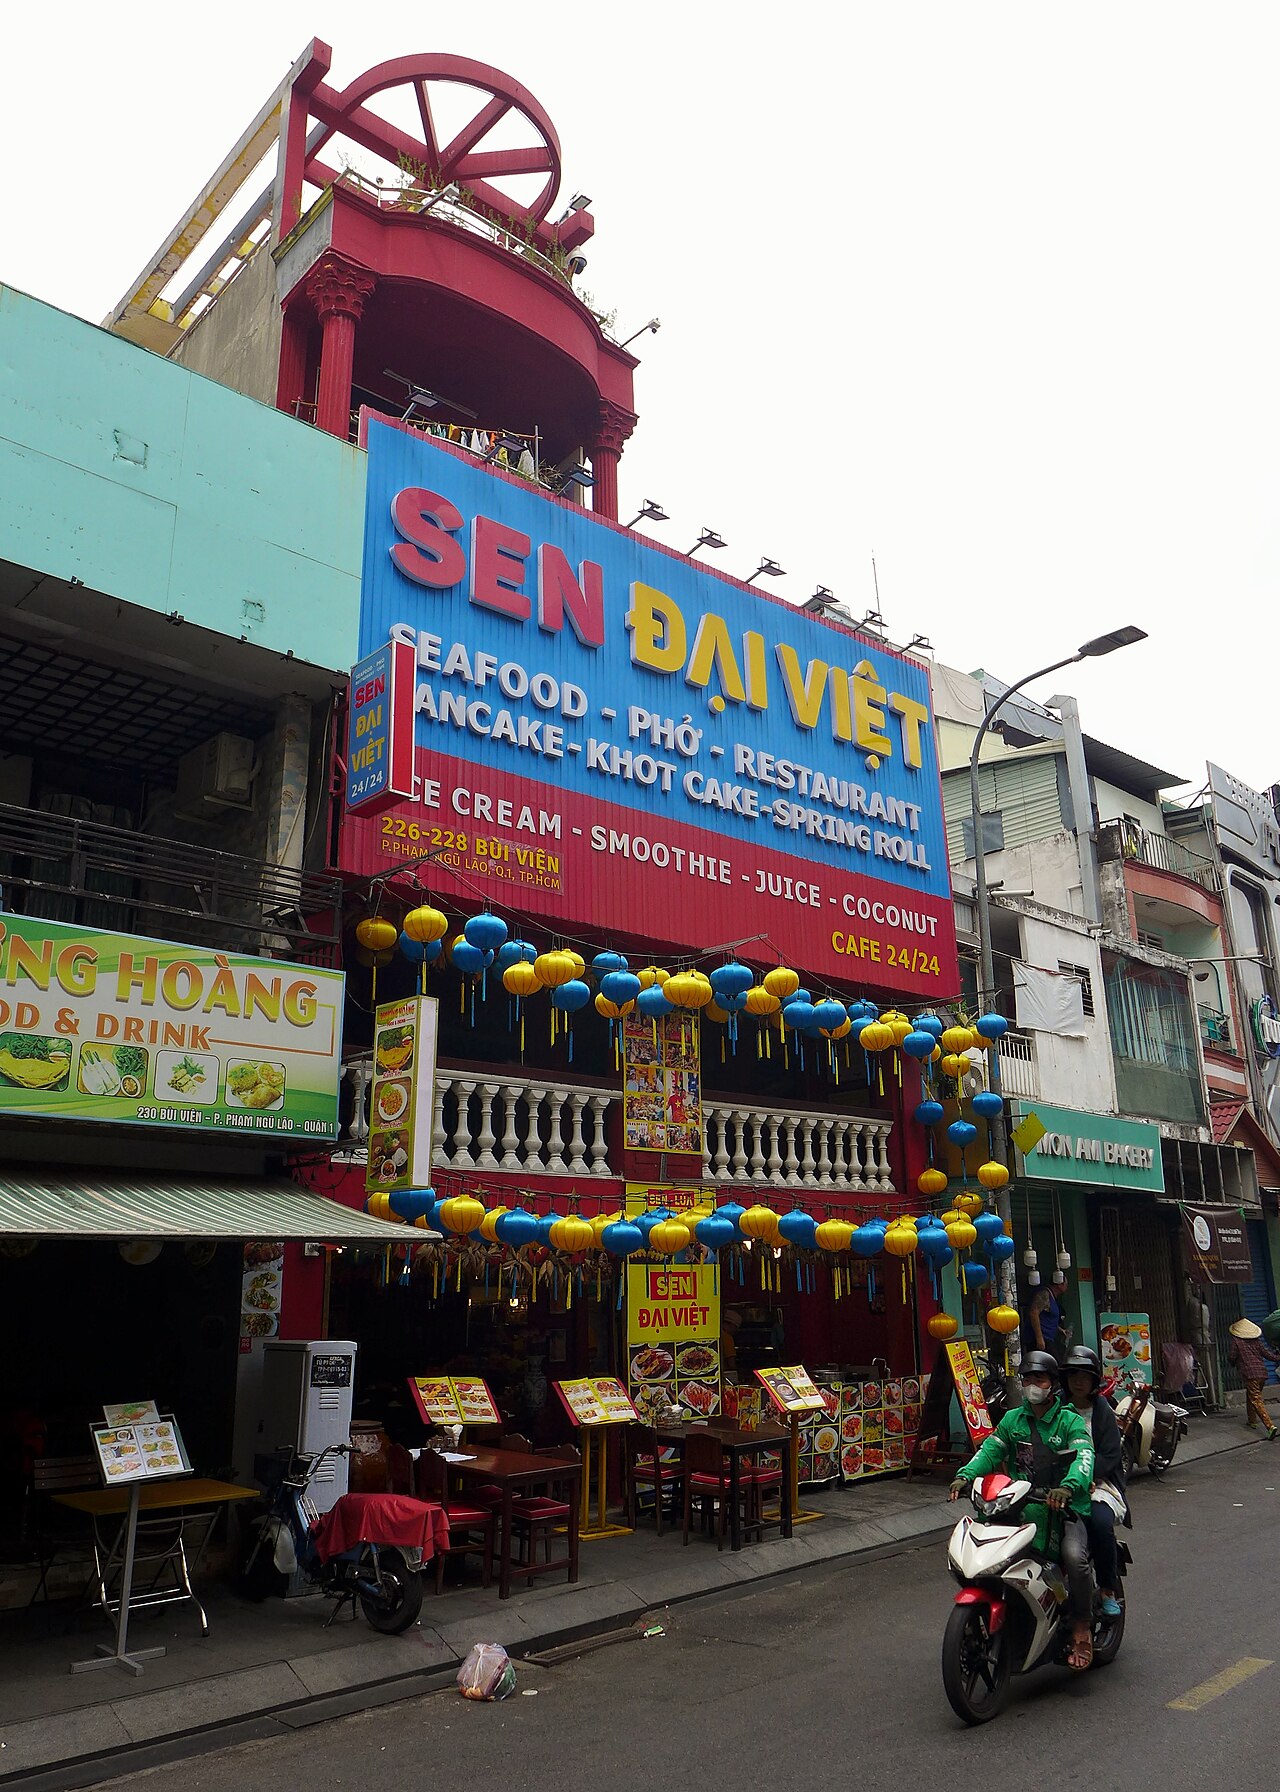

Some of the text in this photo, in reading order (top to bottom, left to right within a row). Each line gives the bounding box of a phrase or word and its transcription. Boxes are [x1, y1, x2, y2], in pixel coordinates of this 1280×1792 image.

[388, 487, 928, 771] SEN ĐẠI VIỆT
[354, 672, 385, 709] SEN
[355, 704, 383, 736] ĐẠI
[389, 623, 588, 719] SEAFOOD
[628, 706, 702, 756] PHỞ
[734, 743, 922, 832] RESTAURANT
[351, 737, 386, 772] VIỆT
[351, 770, 384, 798] 24/24
[381, 816, 560, 874] 226-228 BÙI VIỆN
[451, 787, 562, 840] CREAM
[590, 826, 732, 885] SMOOTHIE
[755, 869, 821, 909] JUICE
[842, 894, 938, 938] COCONUT
[874, 832, 931, 871] ROLL
[519, 870, 561, 890] TP.HCM
[831, 931, 940, 976] CAFE 24/24
[116, 954, 318, 1027] HOÀNG
[54, 1006, 80, 1036] &
[96, 1013, 212, 1051] DRINK
[136, 1106, 157, 1120] 230
[180, 1108, 202, 1125] VIỆN
[213, 1112, 223, 1126] P.
[225, 1113, 254, 1129] PHẠM
[304, 1120, 327, 1135] QUẬN
[329, 1121, 334, 1134] 1
[1037, 1132, 1073, 1158] MON
[1103, 1141, 1154, 1169] BAKERY
[656, 1276, 693, 1296] SEN
[638, 1301, 710, 1334] ĐẠI VIỆT
[1079, 1448, 1092, 1477] Grab
